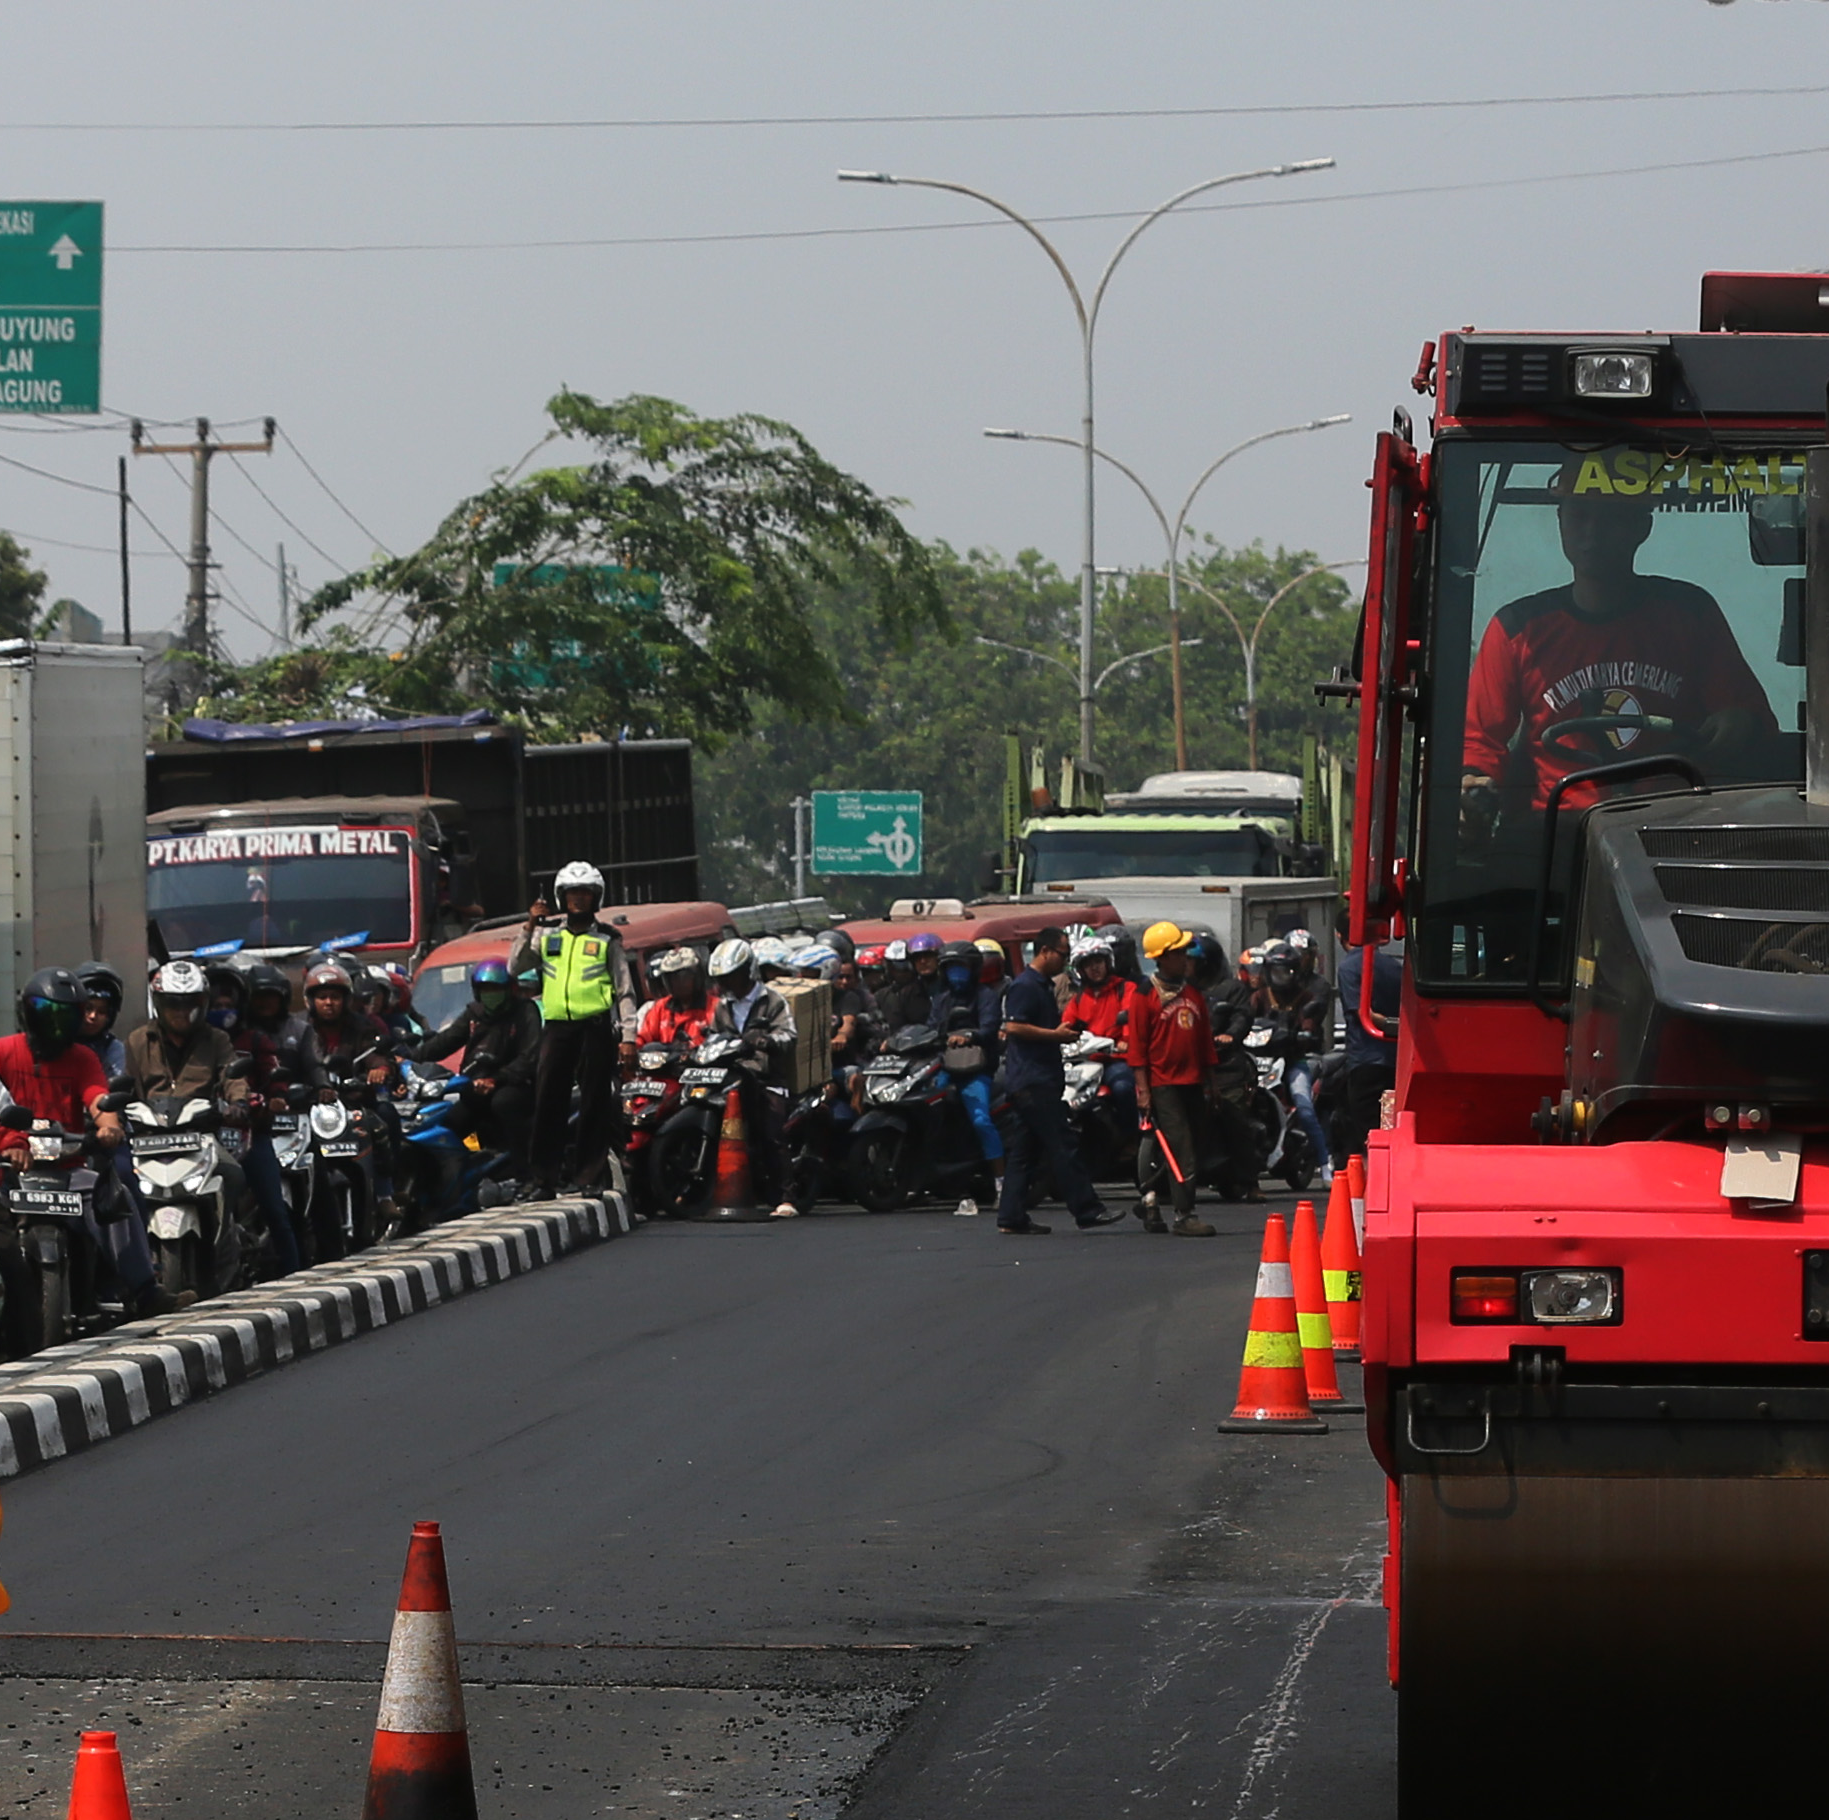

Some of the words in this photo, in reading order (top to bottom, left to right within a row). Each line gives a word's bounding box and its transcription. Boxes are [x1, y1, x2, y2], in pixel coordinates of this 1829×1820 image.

[1622, 661, 1683, 699] CEMERLANG
[245, 832, 314, 858] PRIMA
[320, 830, 399, 855] METAL
[913, 901, 936, 916] 07
